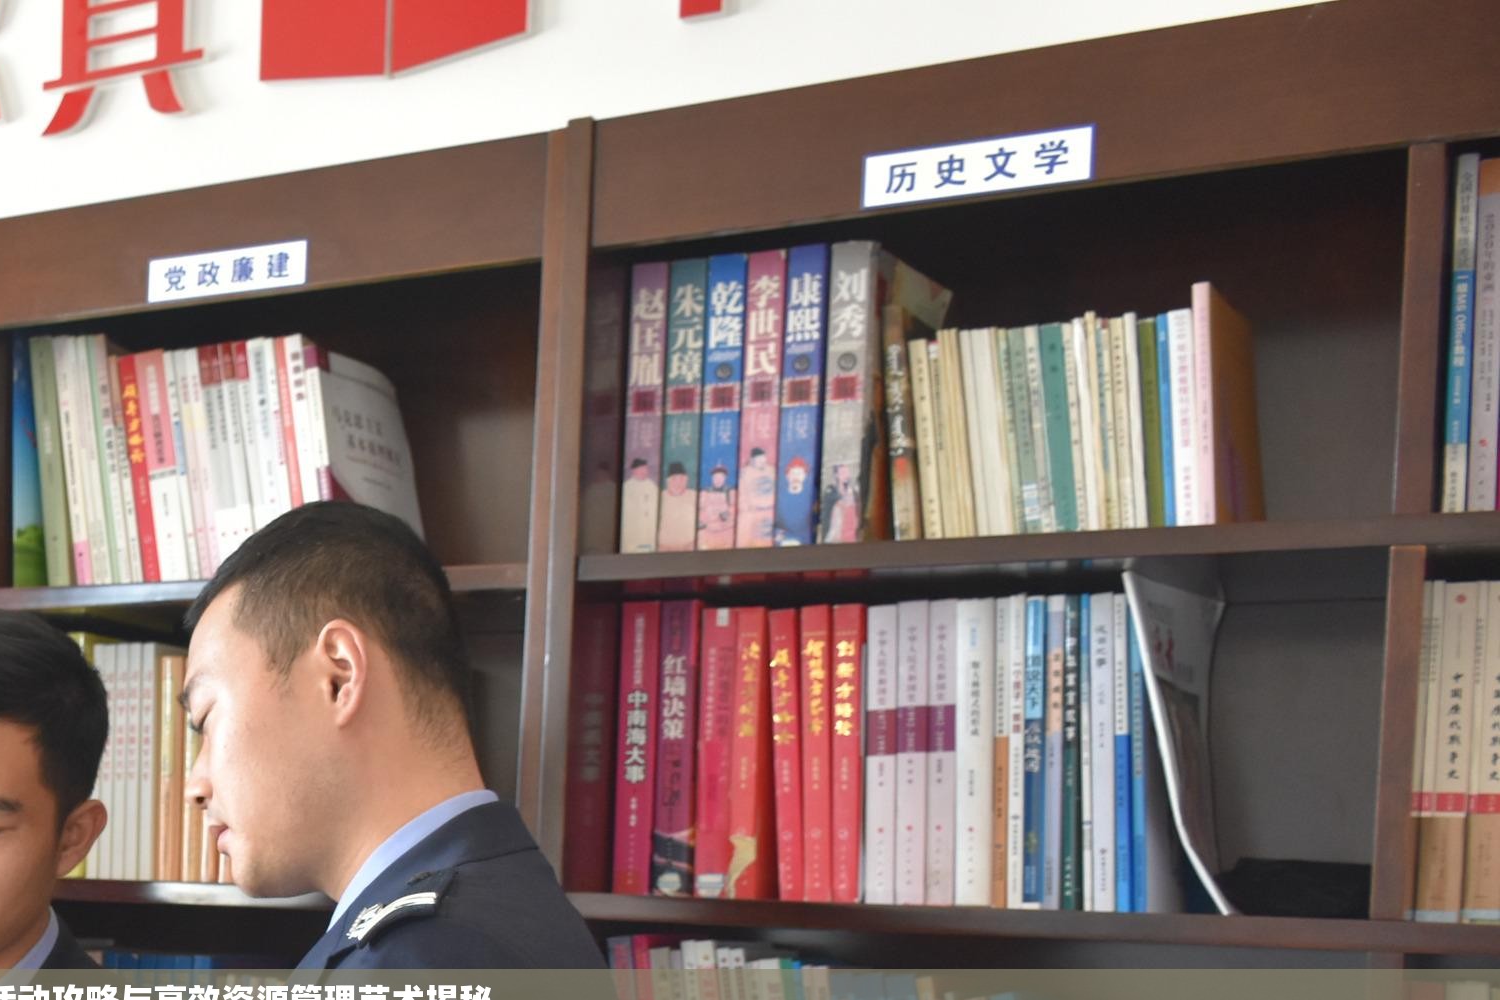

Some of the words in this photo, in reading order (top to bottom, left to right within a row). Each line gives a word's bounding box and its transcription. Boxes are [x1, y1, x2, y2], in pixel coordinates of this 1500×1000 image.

[886, 140, 1069, 195] 历史文学
[163, 250, 291, 293] 党政廉建
[786, 272, 822, 343] 康熙
[832, 268, 869, 339] 刘秀
[629, 287, 665, 387] 赵匡胤
[668, 283, 704, 384] 朱元璋
[708, 281, 745, 349] 乾隆
[746, 275, 780, 377] 李世民
[661, 654, 688, 740] 红墙决策
[624, 690, 648, 784] 中南海大事
